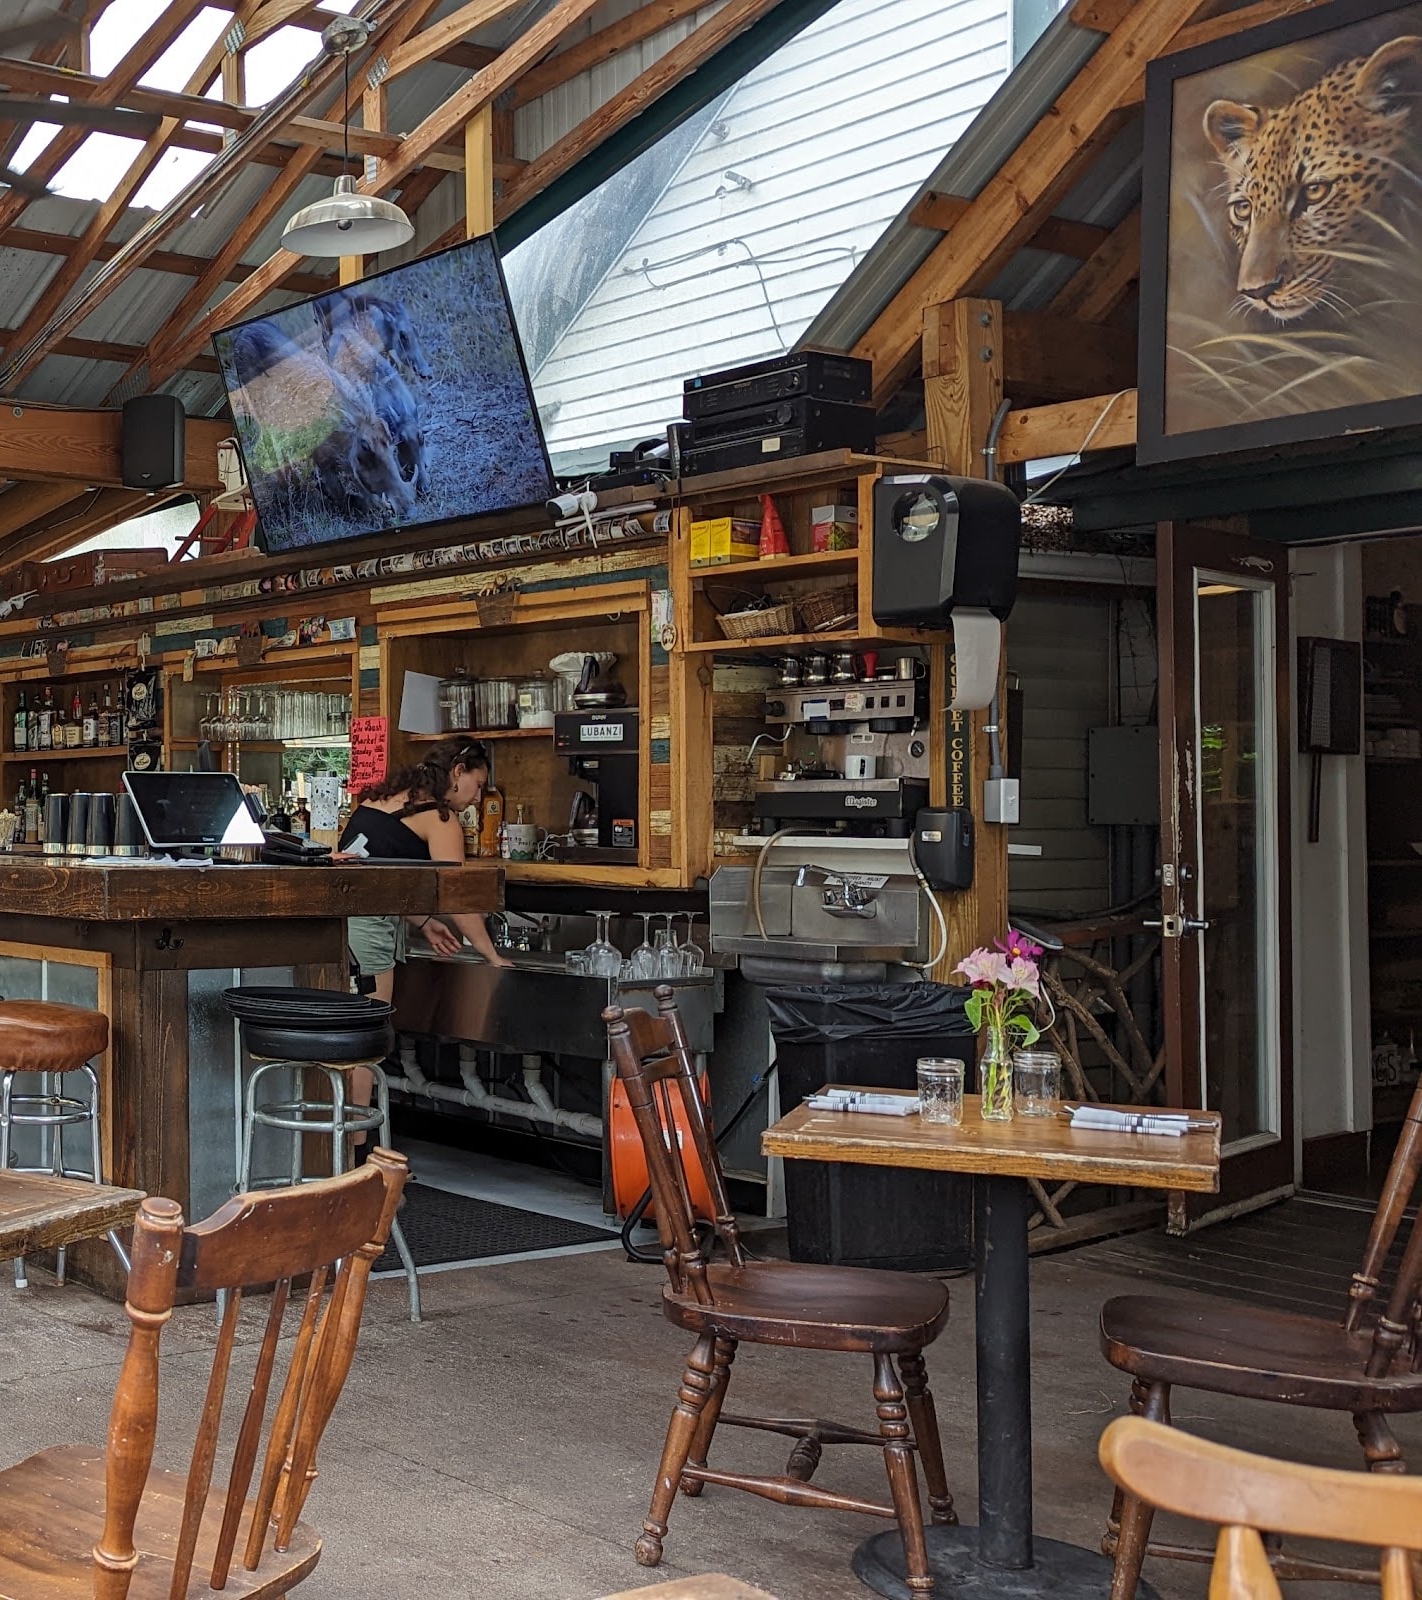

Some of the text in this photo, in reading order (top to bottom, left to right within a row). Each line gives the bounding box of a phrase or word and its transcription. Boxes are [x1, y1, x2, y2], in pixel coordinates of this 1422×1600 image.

[581, 726, 622, 737] LUBANZI
[951, 738, 964, 807] COFFEE
[845, 795, 878, 809] Magister
